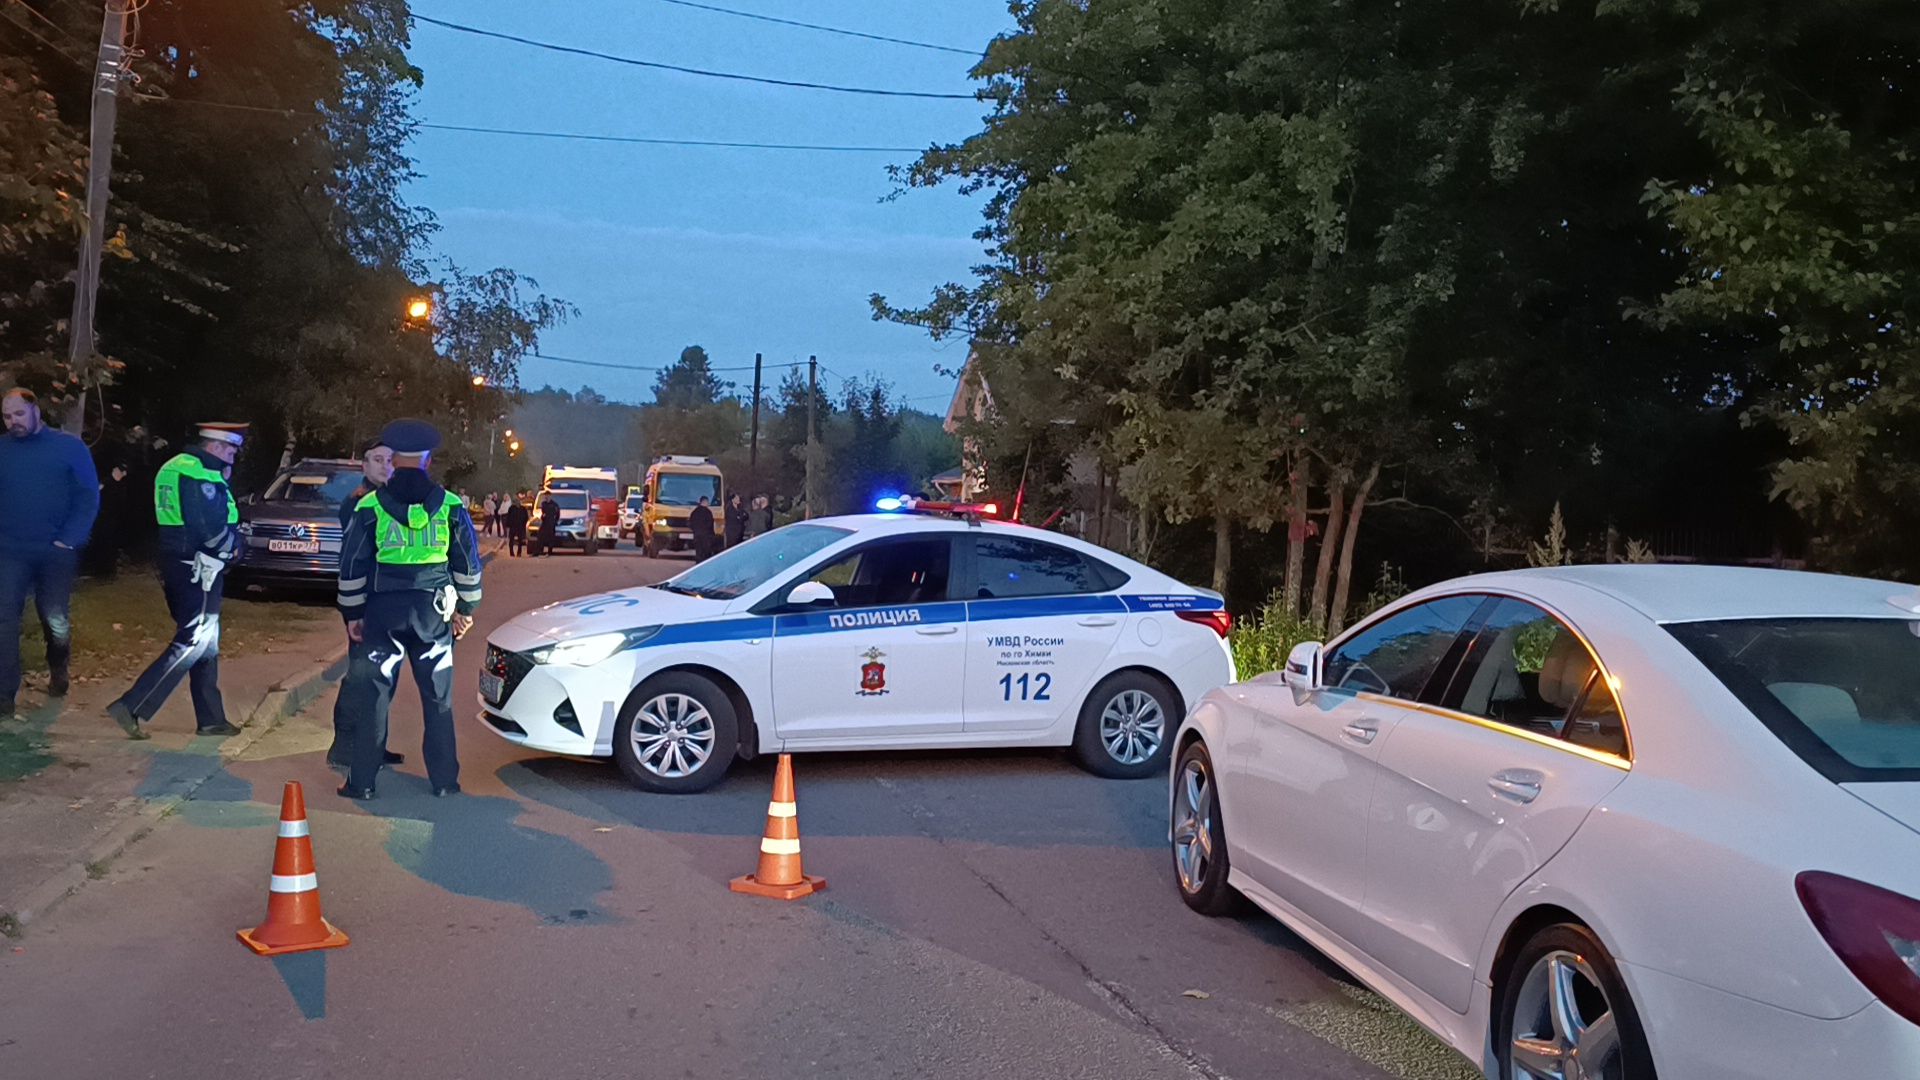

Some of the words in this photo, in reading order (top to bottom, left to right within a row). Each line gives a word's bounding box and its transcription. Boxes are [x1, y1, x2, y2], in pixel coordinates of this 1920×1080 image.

[829, 608, 921, 628] ПОЛИЦИЯ
[987, 636, 1021, 648] УМВД
[1024, 636, 1064, 646] России
[1025, 649, 1052, 657] Химки
[1000, 672, 1051, 701] 112
